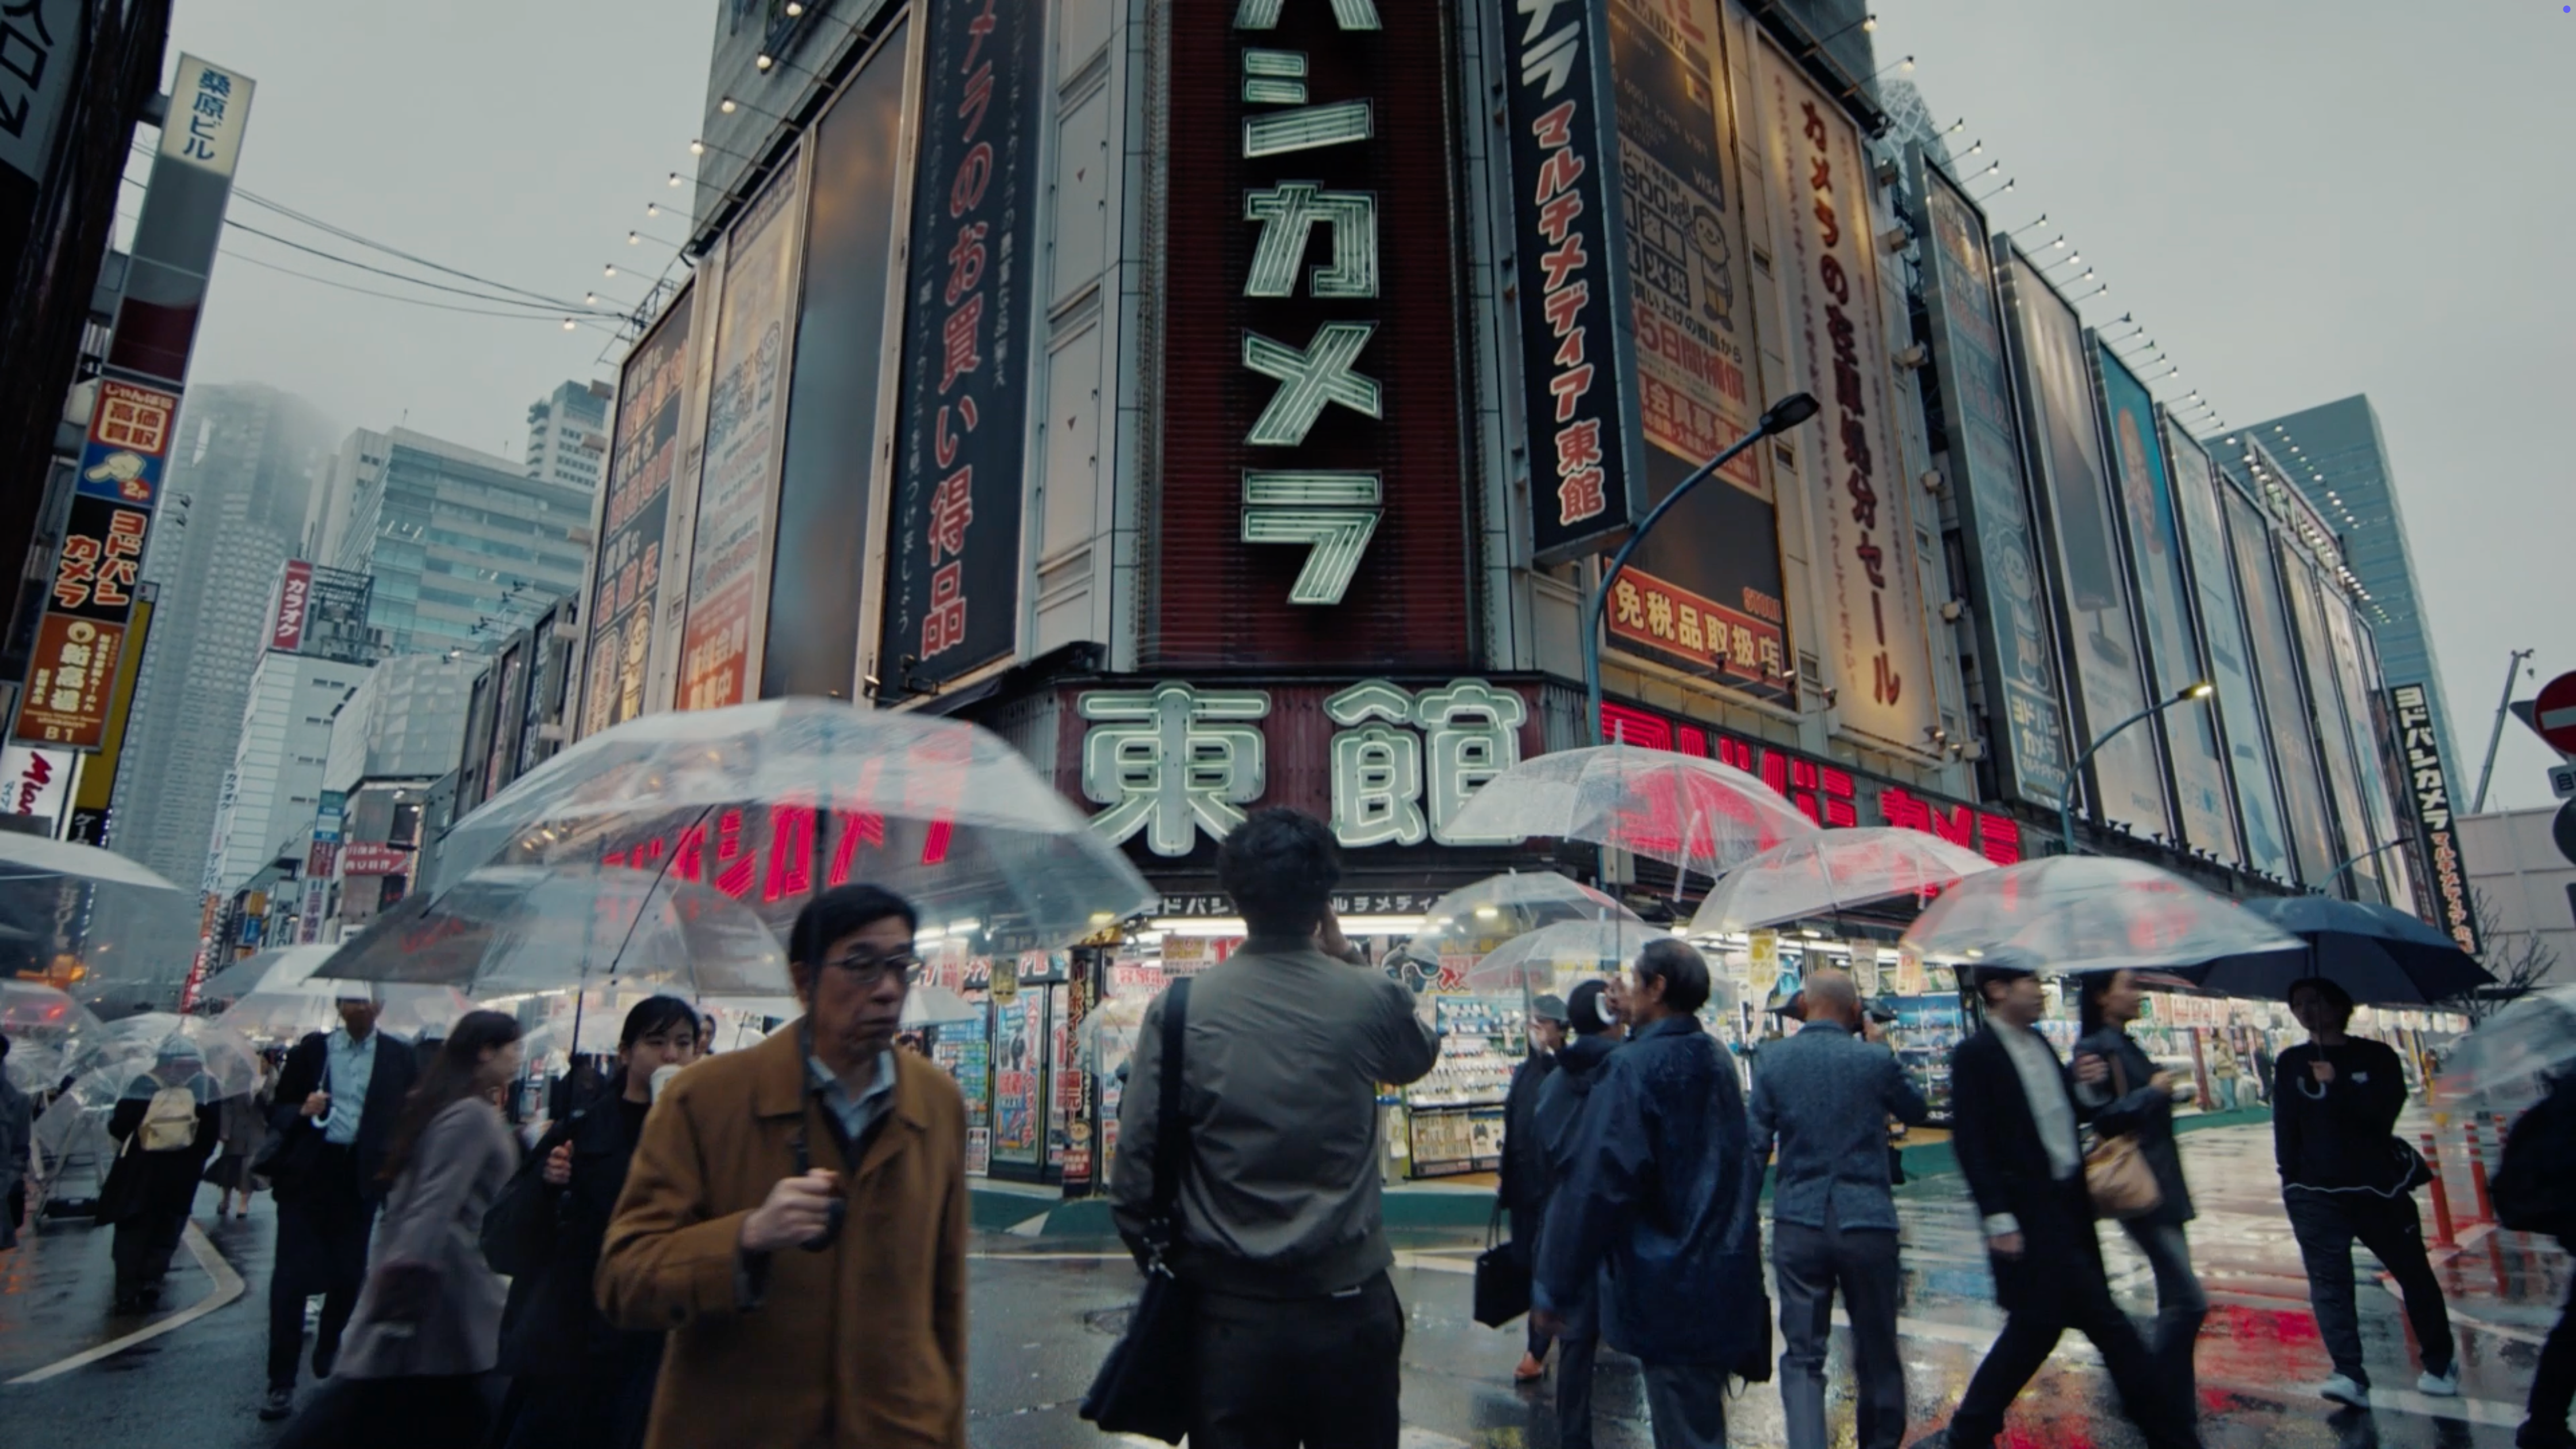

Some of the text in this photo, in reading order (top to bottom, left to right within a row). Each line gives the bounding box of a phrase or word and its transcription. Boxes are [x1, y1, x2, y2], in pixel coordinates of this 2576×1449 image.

[182, 67, 231, 161] 桑原ビル
[1692, 166, 1722, 202] VISA
[1233, 0, 1384, 604] シカメラ
[1532, 99, 1607, 527] マルチメディア東館
[53, 535, 102, 608] カメラ
[93, 509, 148, 606] ヨドバシ
[277, 578, 307, 638] カラオケ
[1615, 578, 1781, 679] 免税品取扱店
[45, 726, 74, 743] B1
[2011, 693, 2056, 736] ヨドバシ
[2022, 729, 2058, 764] カメラ
[1078, 678, 1525, 856] 東館
[2394, 685, 2450, 830] ヨドバシカメラ
[2556, 772, 2576, 792] 自
